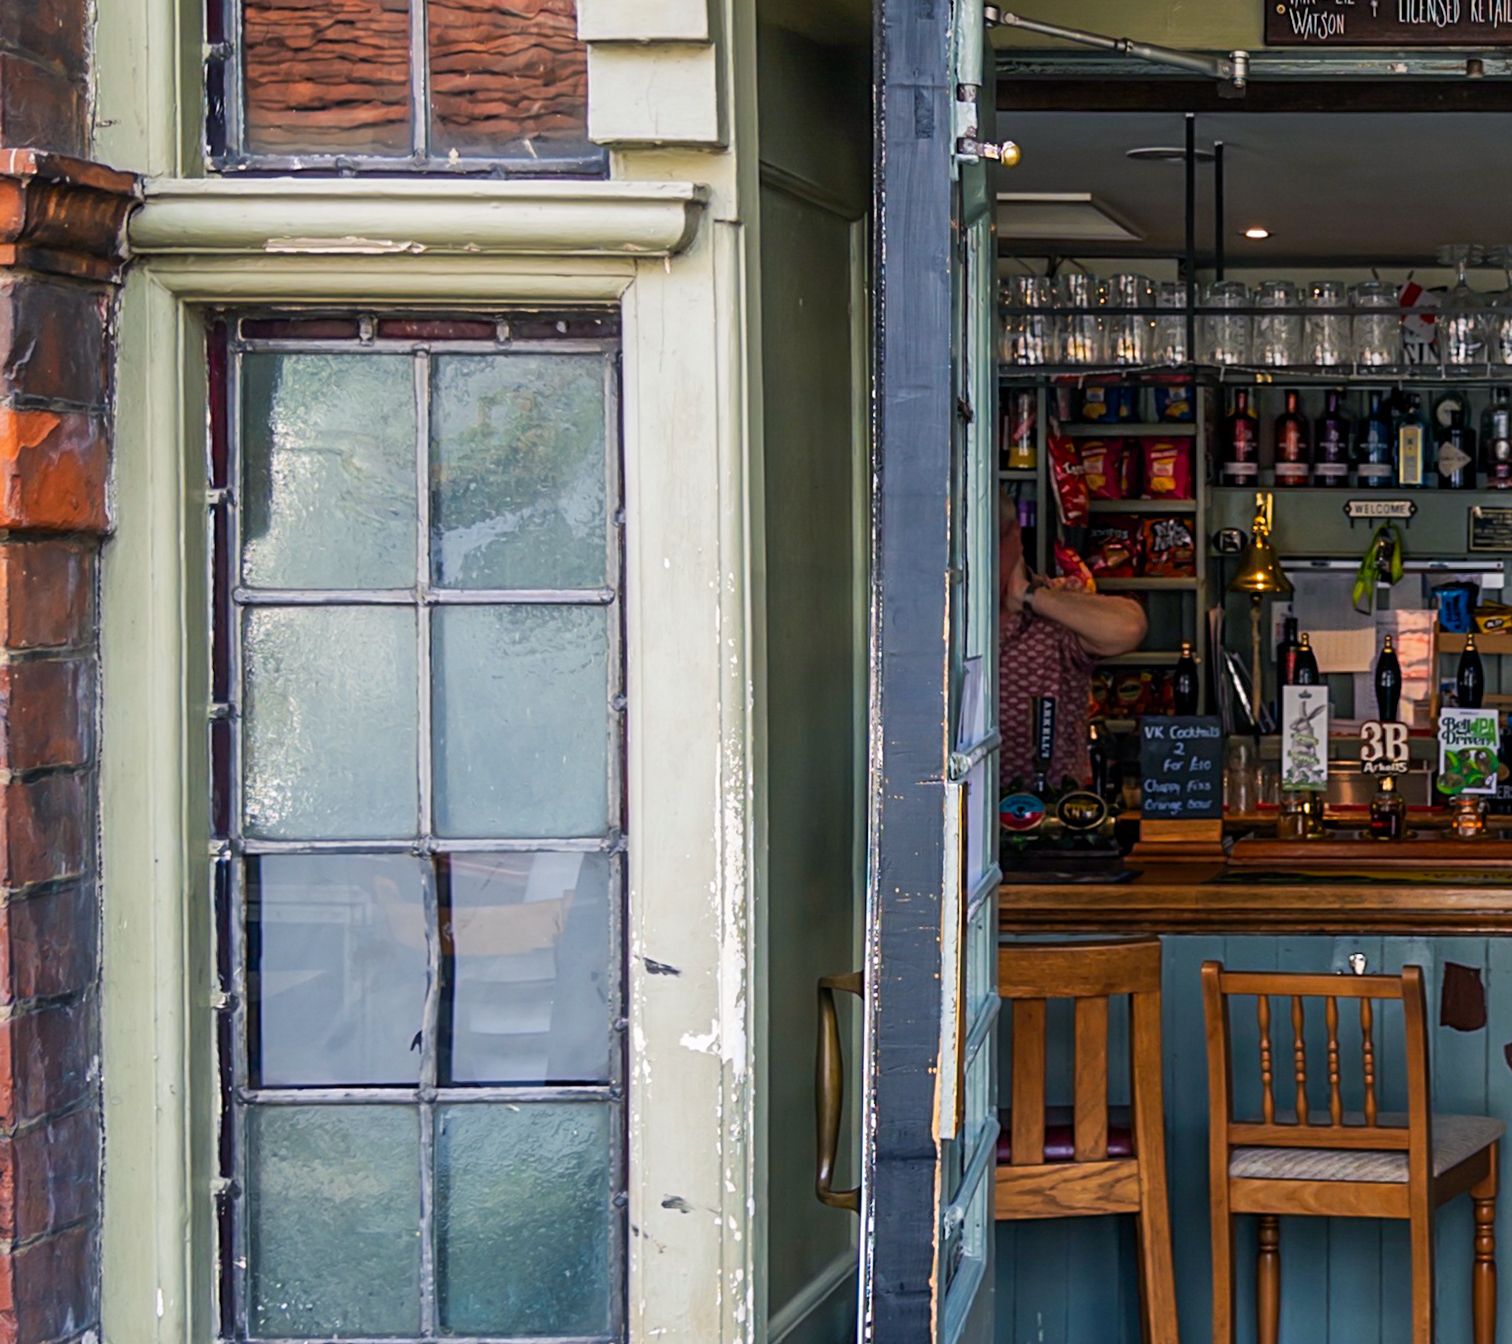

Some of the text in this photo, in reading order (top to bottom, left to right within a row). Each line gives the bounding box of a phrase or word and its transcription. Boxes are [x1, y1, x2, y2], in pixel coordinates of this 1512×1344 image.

[1288, 8, 1345, 40] WATSON
[1354, 502, 1407, 514] WELCOME
[1143, 726, 1165, 739] VK
[1360, 721, 1409, 761] 3B
[1173, 742, 1186, 756] 2
